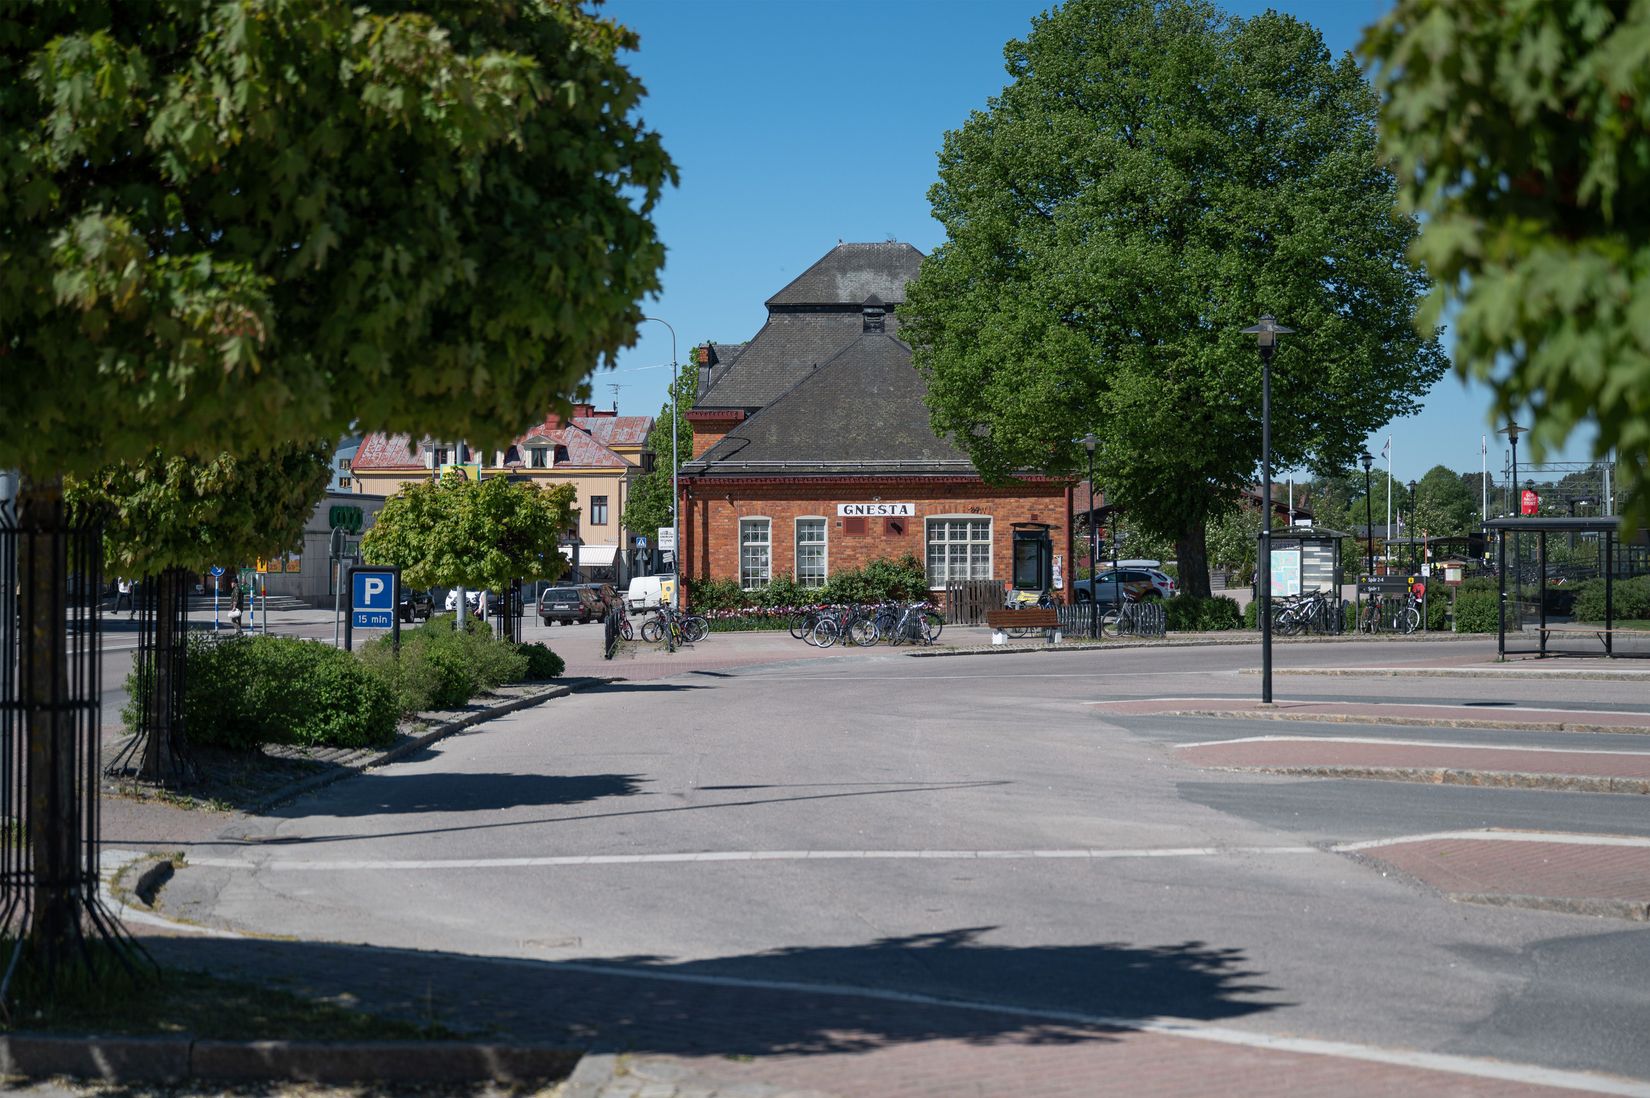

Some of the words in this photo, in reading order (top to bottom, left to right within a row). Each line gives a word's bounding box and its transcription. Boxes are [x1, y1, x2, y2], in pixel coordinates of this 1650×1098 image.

[843, 504, 909, 515] GNESTA
[365, 577, 384, 605] P
[358, 614, 368, 624] 15
[371, 614, 388, 624] min
